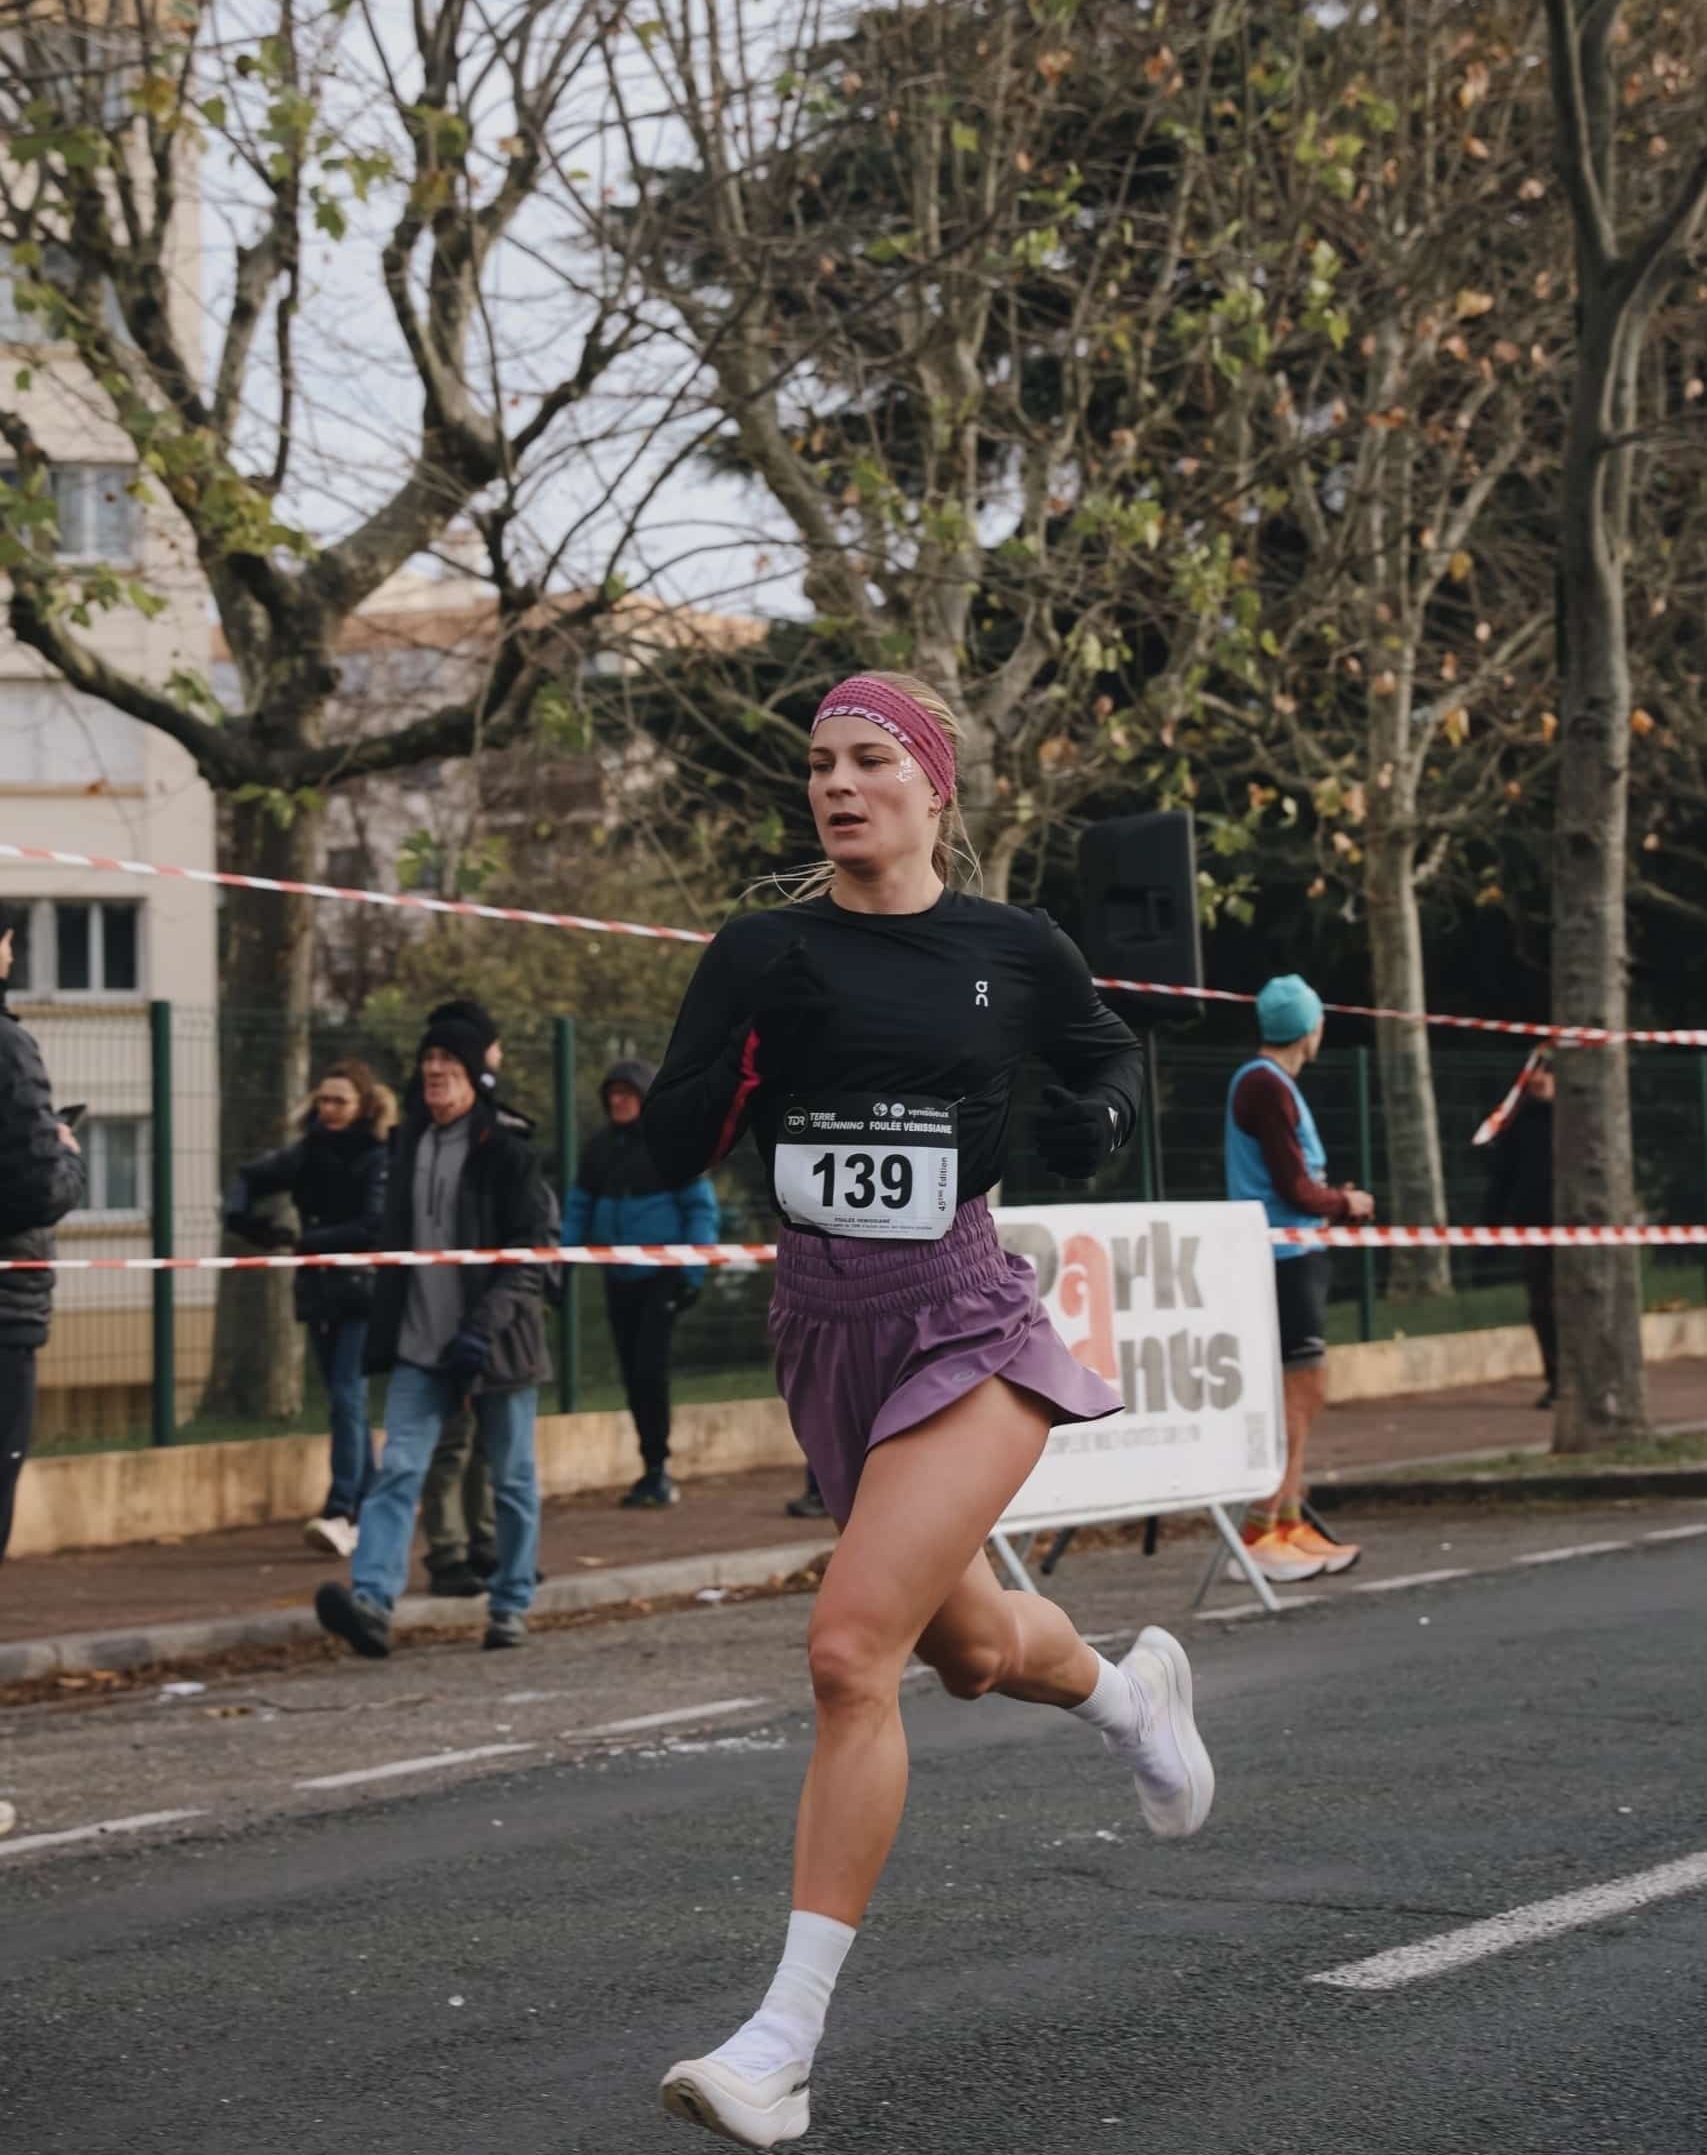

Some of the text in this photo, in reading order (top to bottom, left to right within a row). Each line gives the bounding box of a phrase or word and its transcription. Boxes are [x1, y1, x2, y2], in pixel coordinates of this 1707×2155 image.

[810, 705, 912, 744] SSPORT
[787, 1115, 806, 1126] TDR
[810, 1112, 837, 1121] TERRE
[820, 1121, 864, 1130] RUNNING
[869, 1119, 953, 1134] FOULÉE VÉNISSIANE
[812, 1152, 913, 1209] 139
